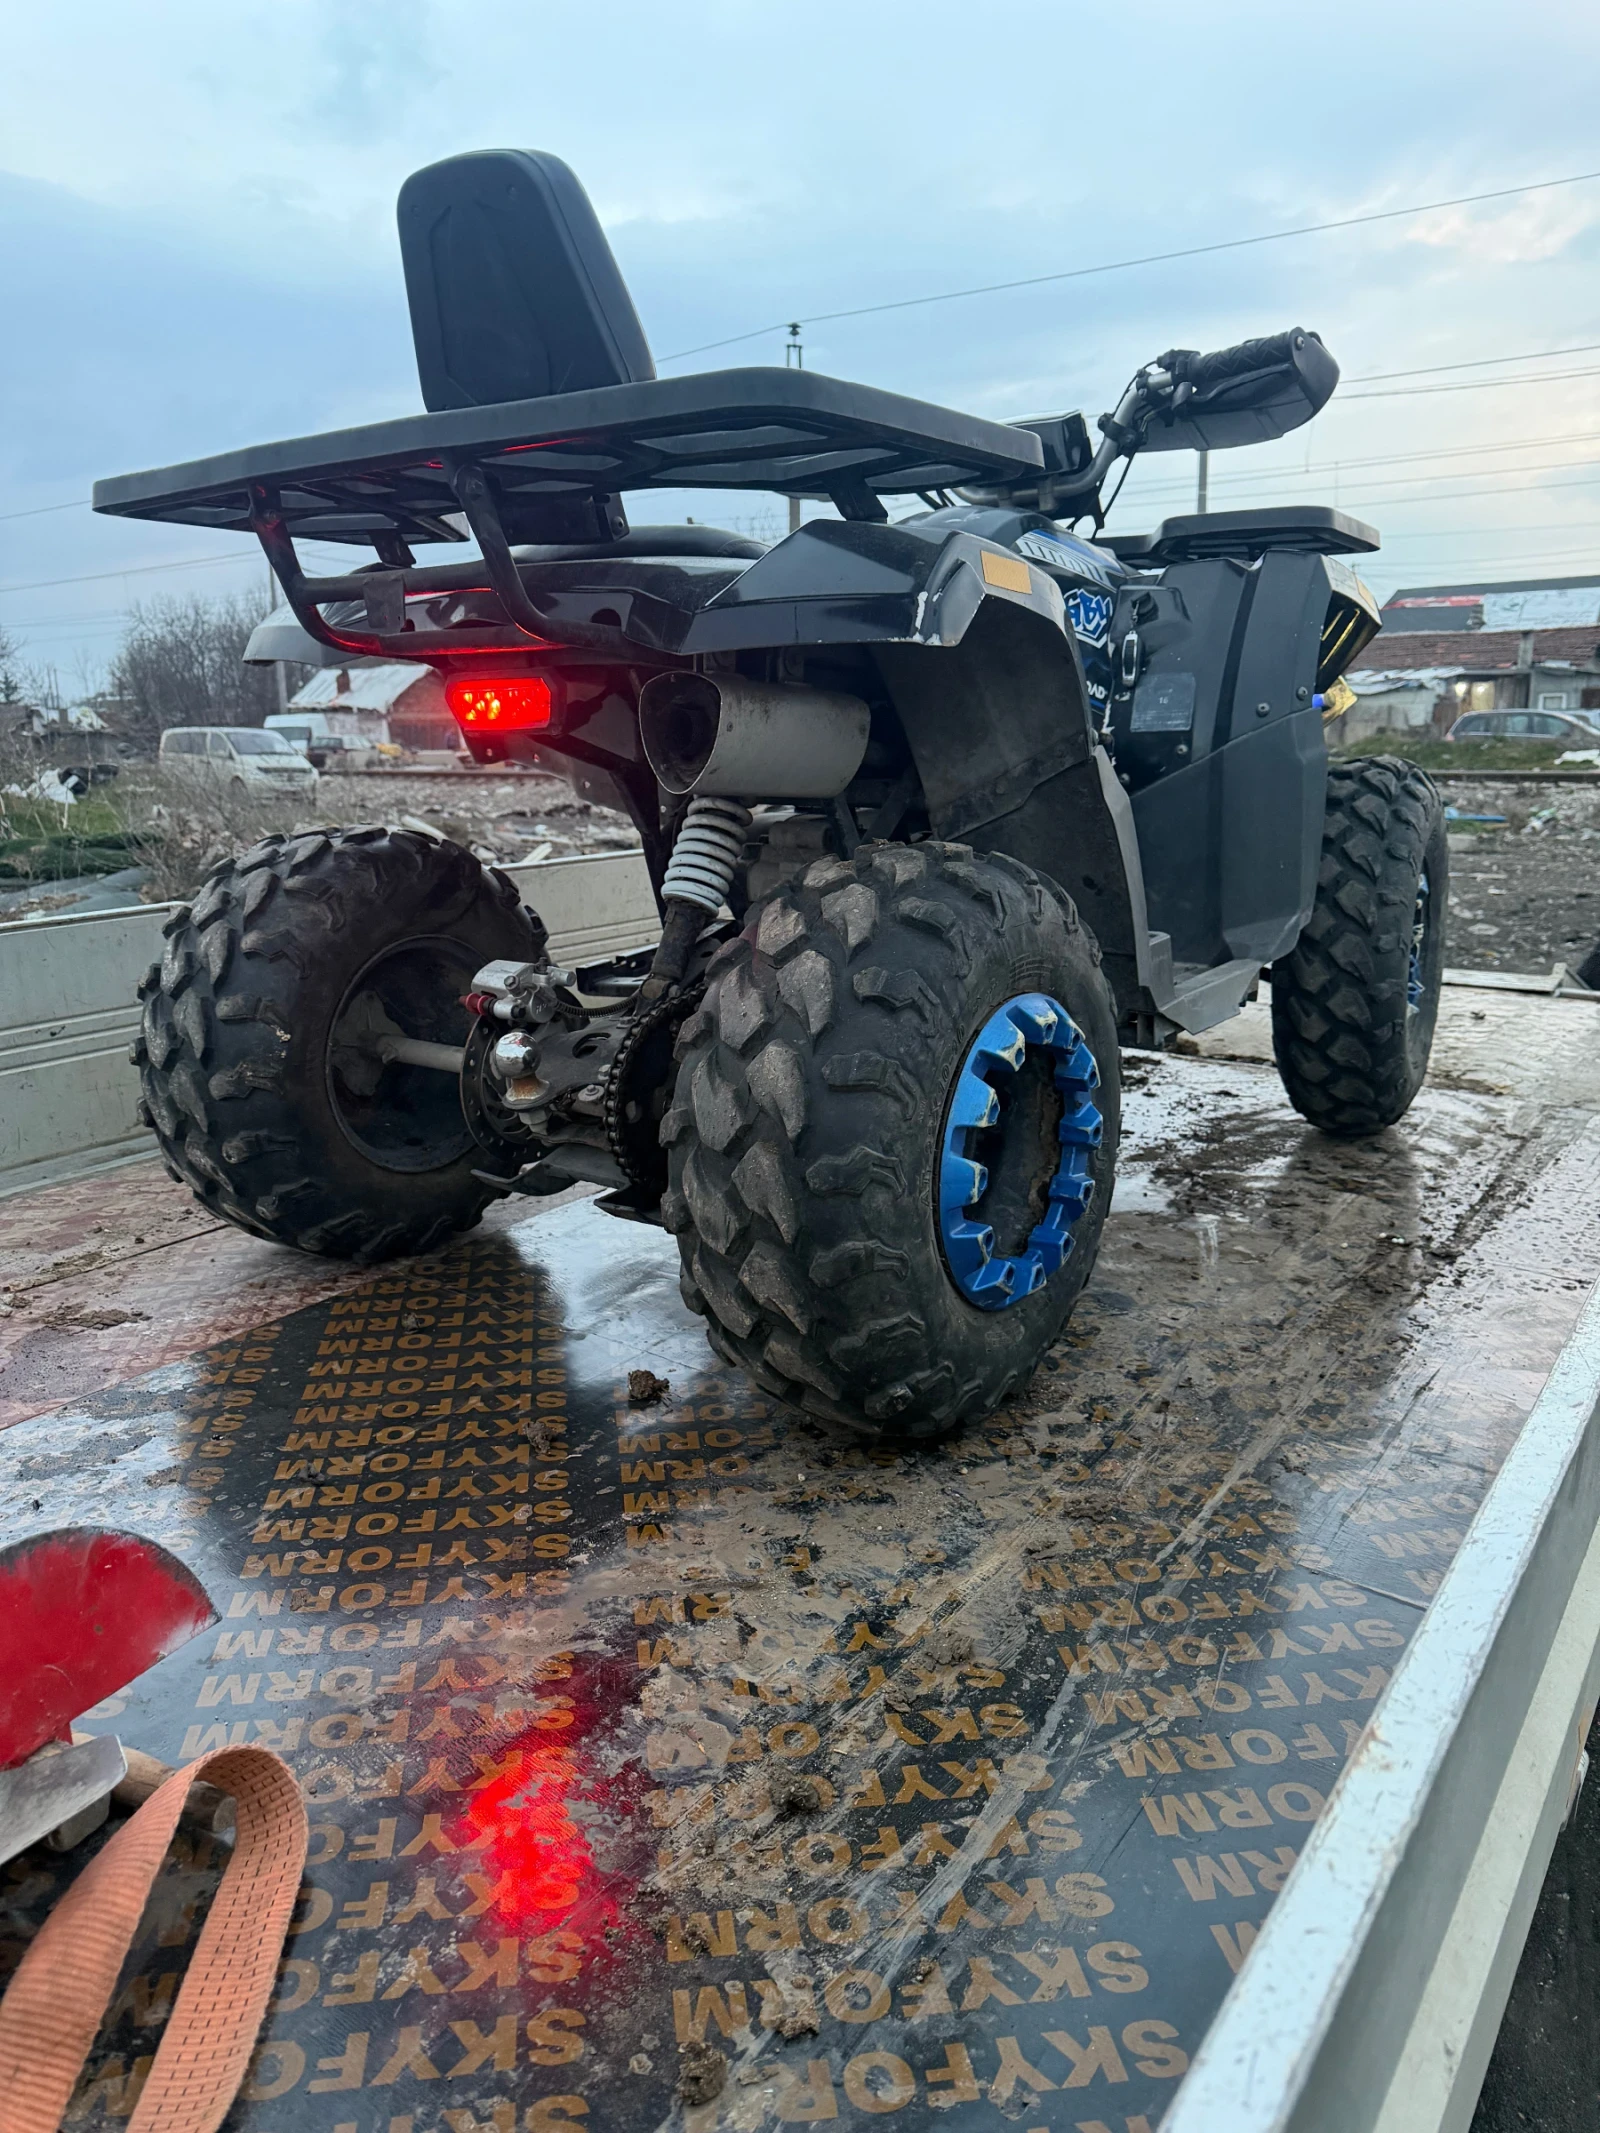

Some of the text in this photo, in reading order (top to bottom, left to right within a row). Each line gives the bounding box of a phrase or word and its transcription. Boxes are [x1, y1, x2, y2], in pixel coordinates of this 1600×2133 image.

[308, 1346, 566, 1377] SKYFORM
[316, 1326, 565, 1356] SKYFORM
[292, 1391, 568, 1425] SKYFORM
[301, 1368, 567, 1400] SKYFORM
[263, 1470, 570, 1511] SKYFORM
[252, 1500, 572, 1544] SKYFORM
[239, 1533, 572, 1580] SKYFORM
[226, 1569, 574, 1619] SKYFORM
[1040, 1580, 1368, 1632] SKYFORM
[1057, 1619, 1406, 1676] SKYFORM
[1084, 1665, 1392, 1725] KYFORM
[301, 1746, 579, 1804] SKYFO
[307, 1803, 578, 1867] SKYFO
[287, 1862, 581, 1935] SKYFO
[270, 1932, 584, 2014] SKYFO
[242, 2009, 587, 2102] SKYFO
[775, 2020, 1189, 2122] SKYFOR
